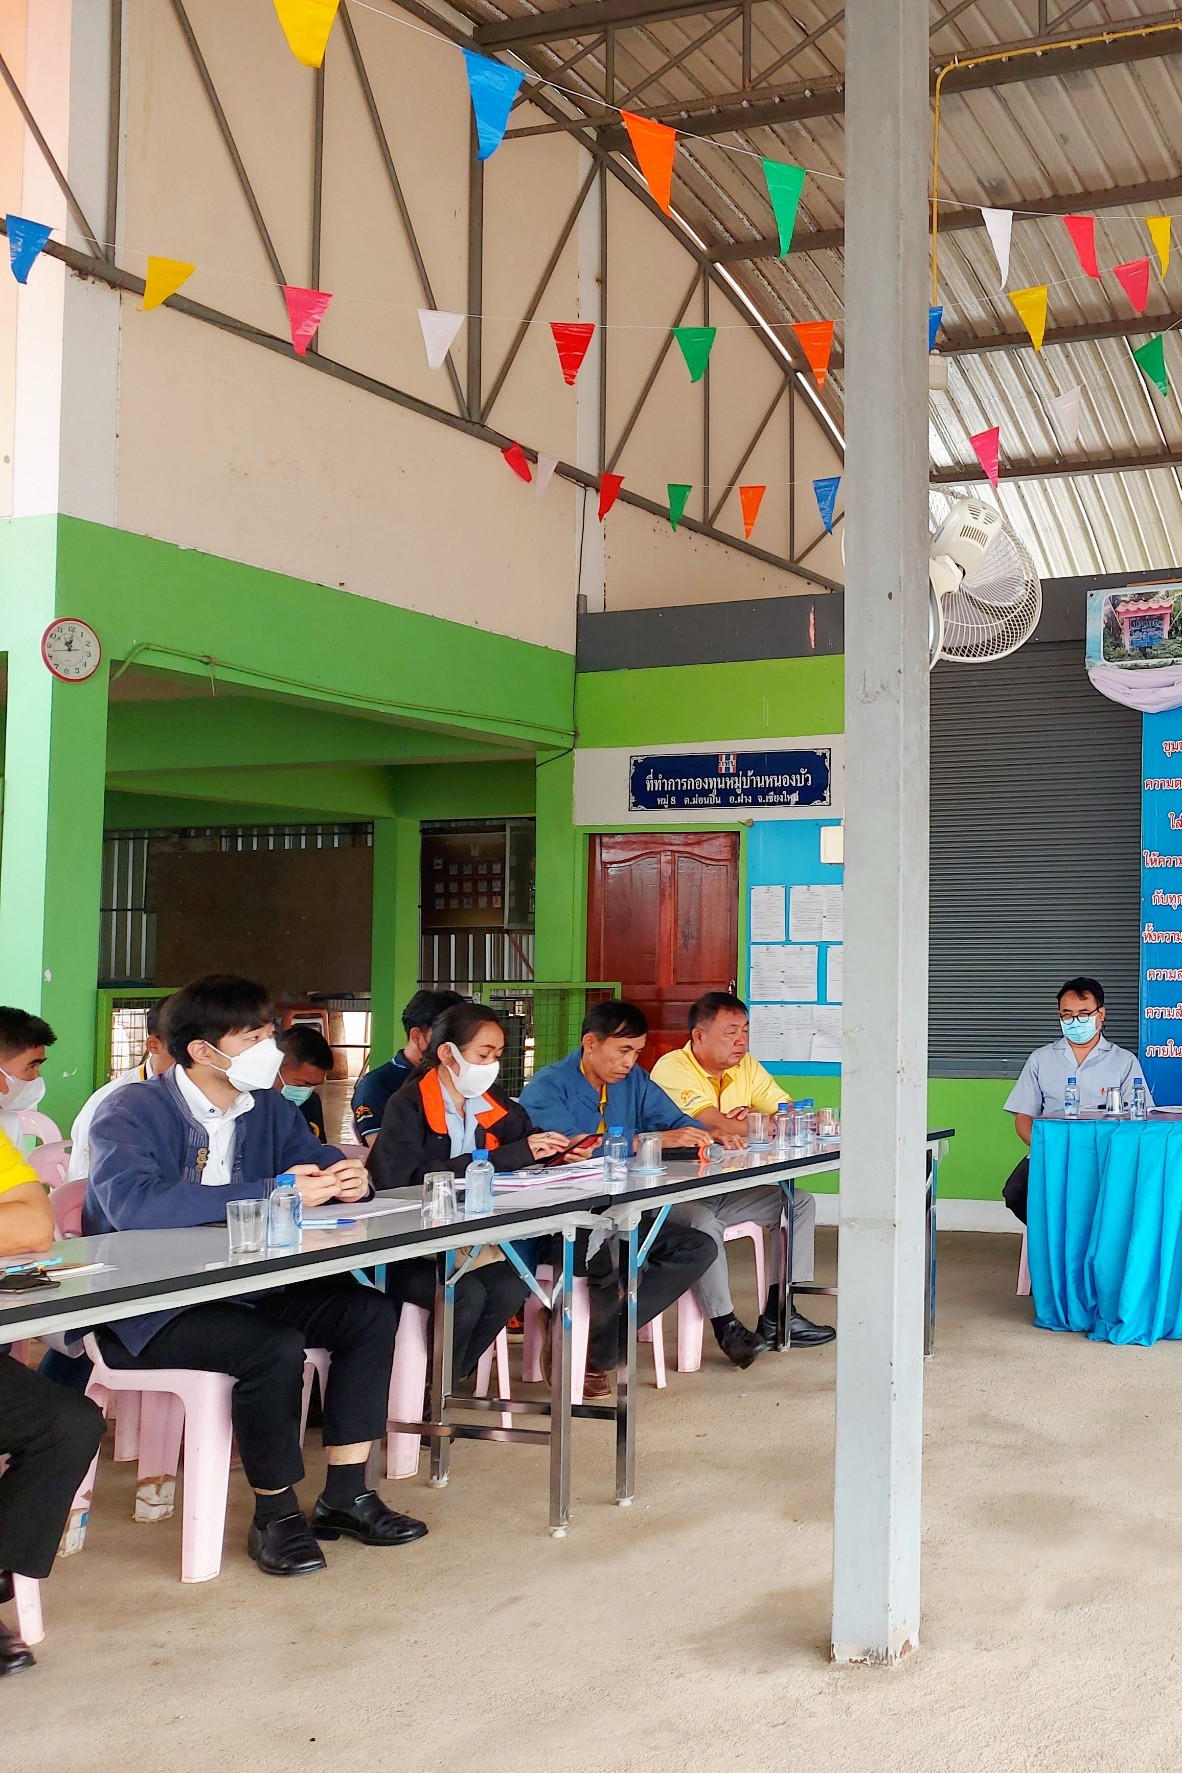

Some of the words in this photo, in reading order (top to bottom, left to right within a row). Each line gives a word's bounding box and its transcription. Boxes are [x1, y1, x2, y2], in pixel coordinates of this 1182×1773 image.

[645, 767, 812, 795] ที่ทำการกองทุนหมู่บ้านหนองบัว
[656, 794, 669, 808] หมู่
[670, 796, 677, 805] 8
